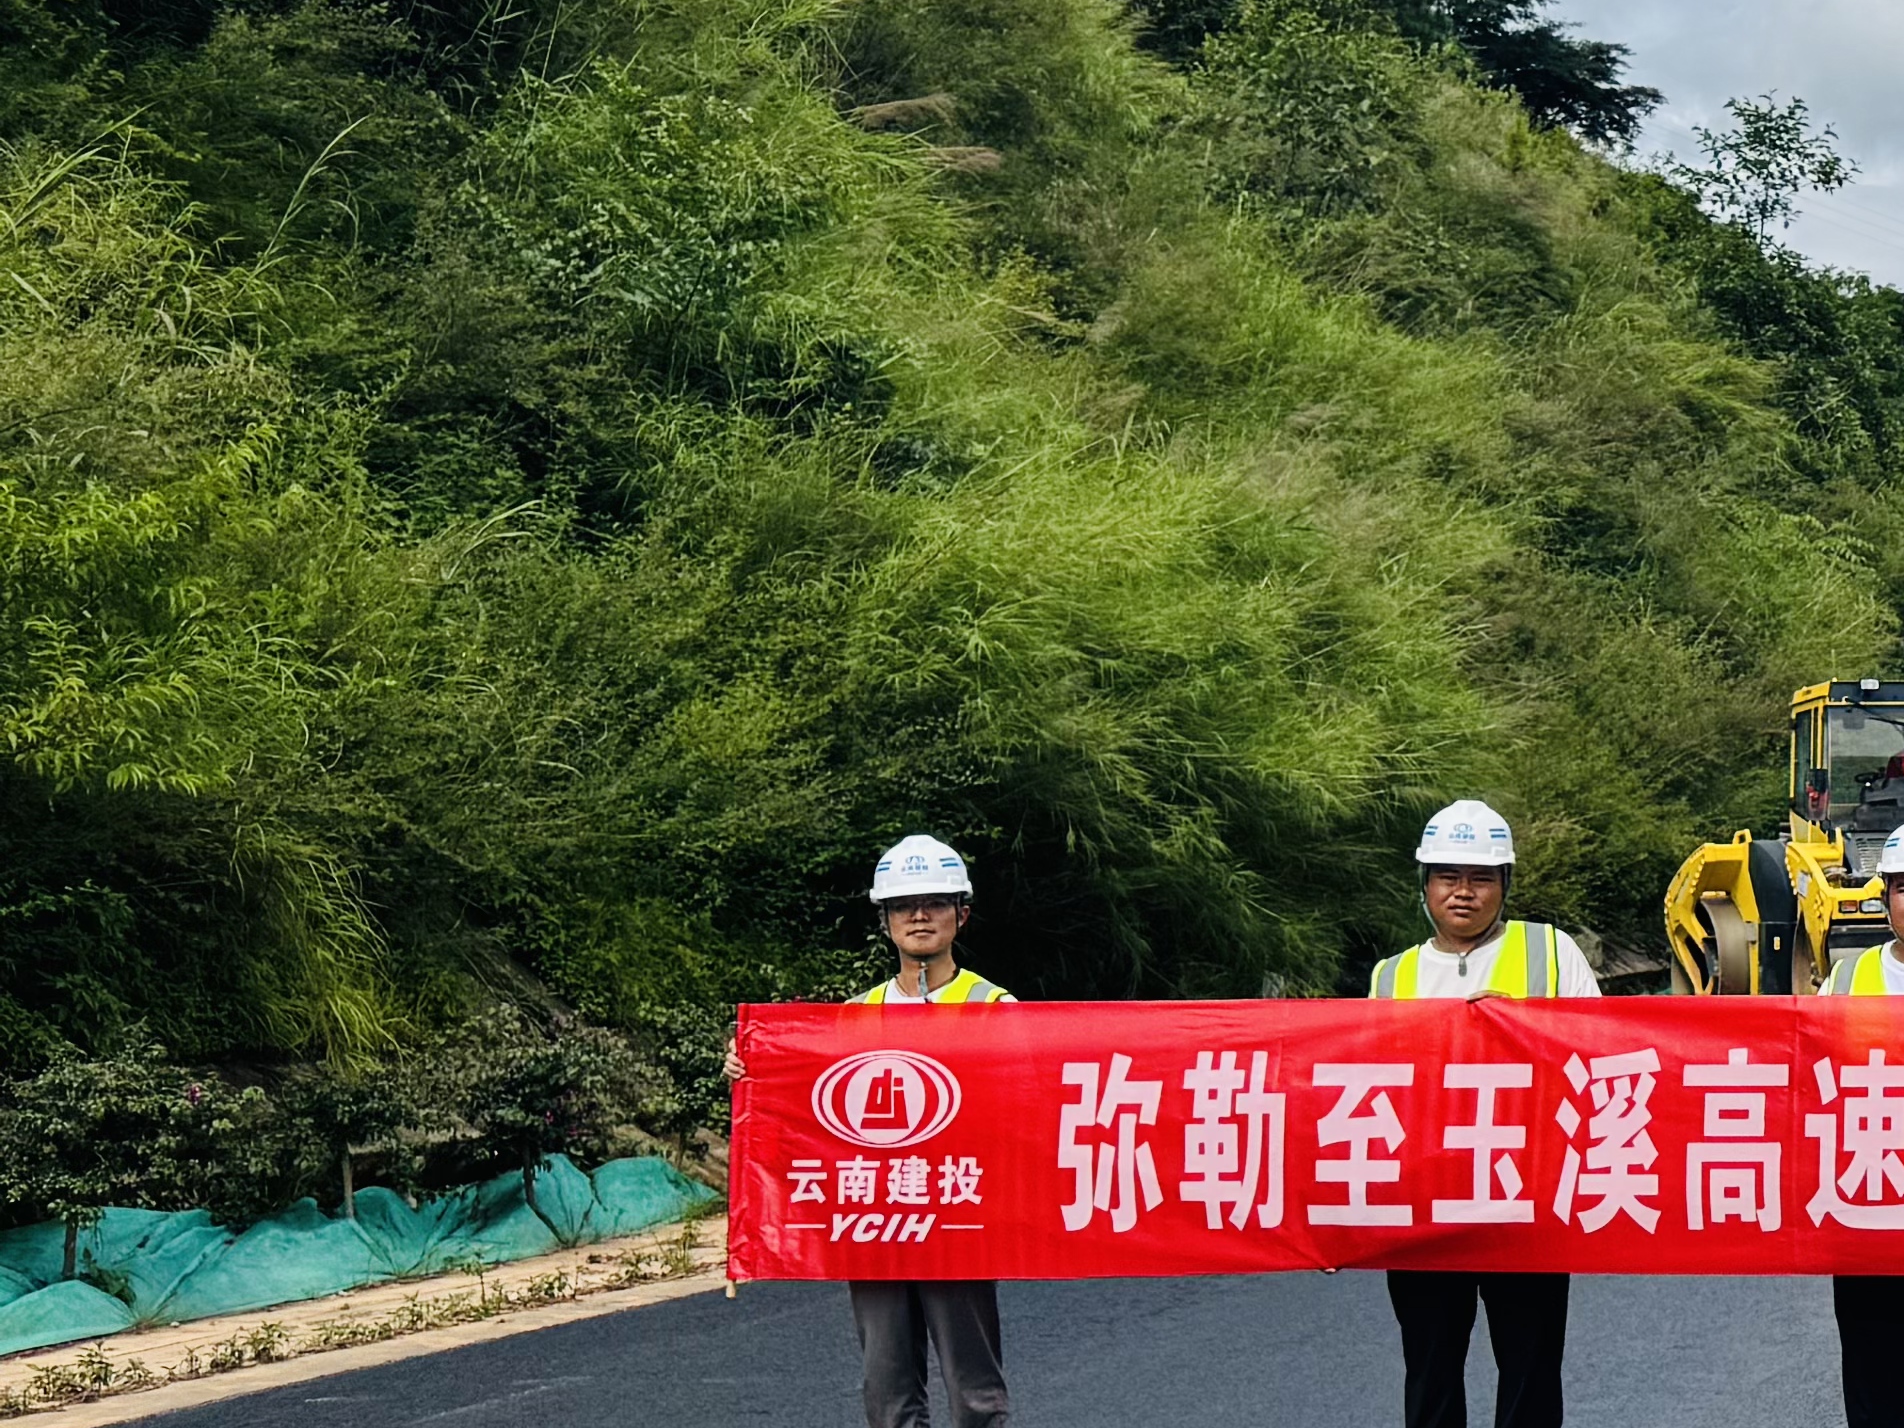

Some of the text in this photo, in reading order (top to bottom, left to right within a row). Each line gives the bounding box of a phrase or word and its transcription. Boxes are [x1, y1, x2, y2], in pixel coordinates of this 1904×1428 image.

[787, 1155, 983, 1205] 云南建投
[830, 1213, 937, 1243] YCIH
